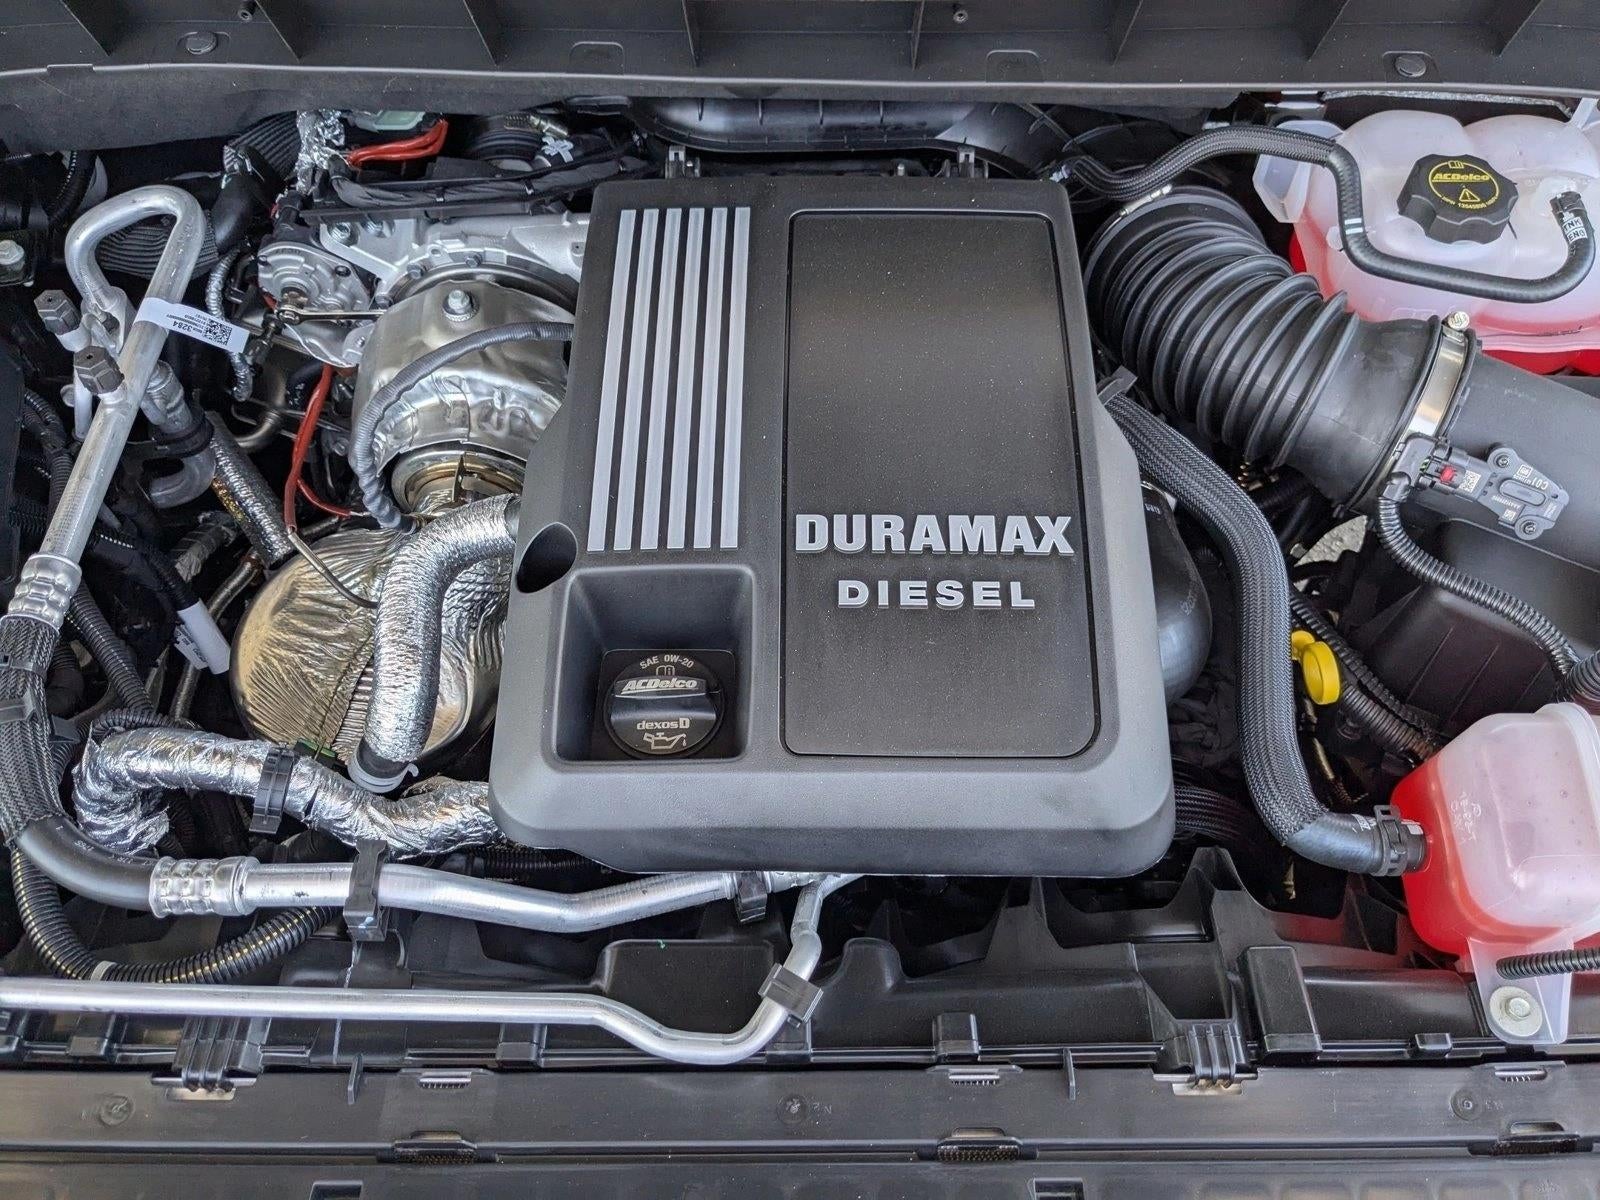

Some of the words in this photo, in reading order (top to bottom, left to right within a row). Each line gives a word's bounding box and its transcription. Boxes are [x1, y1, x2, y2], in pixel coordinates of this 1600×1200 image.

[1432, 173, 1491, 181] ACDelco
[795, 514, 1075, 556] DURAMAX
[838, 580, 1036, 609] DIESEL
[640, 655, 660, 670] SAE
[663, 654, 695, 669] 0W-20
[621, 677, 699, 692] ACDelco
